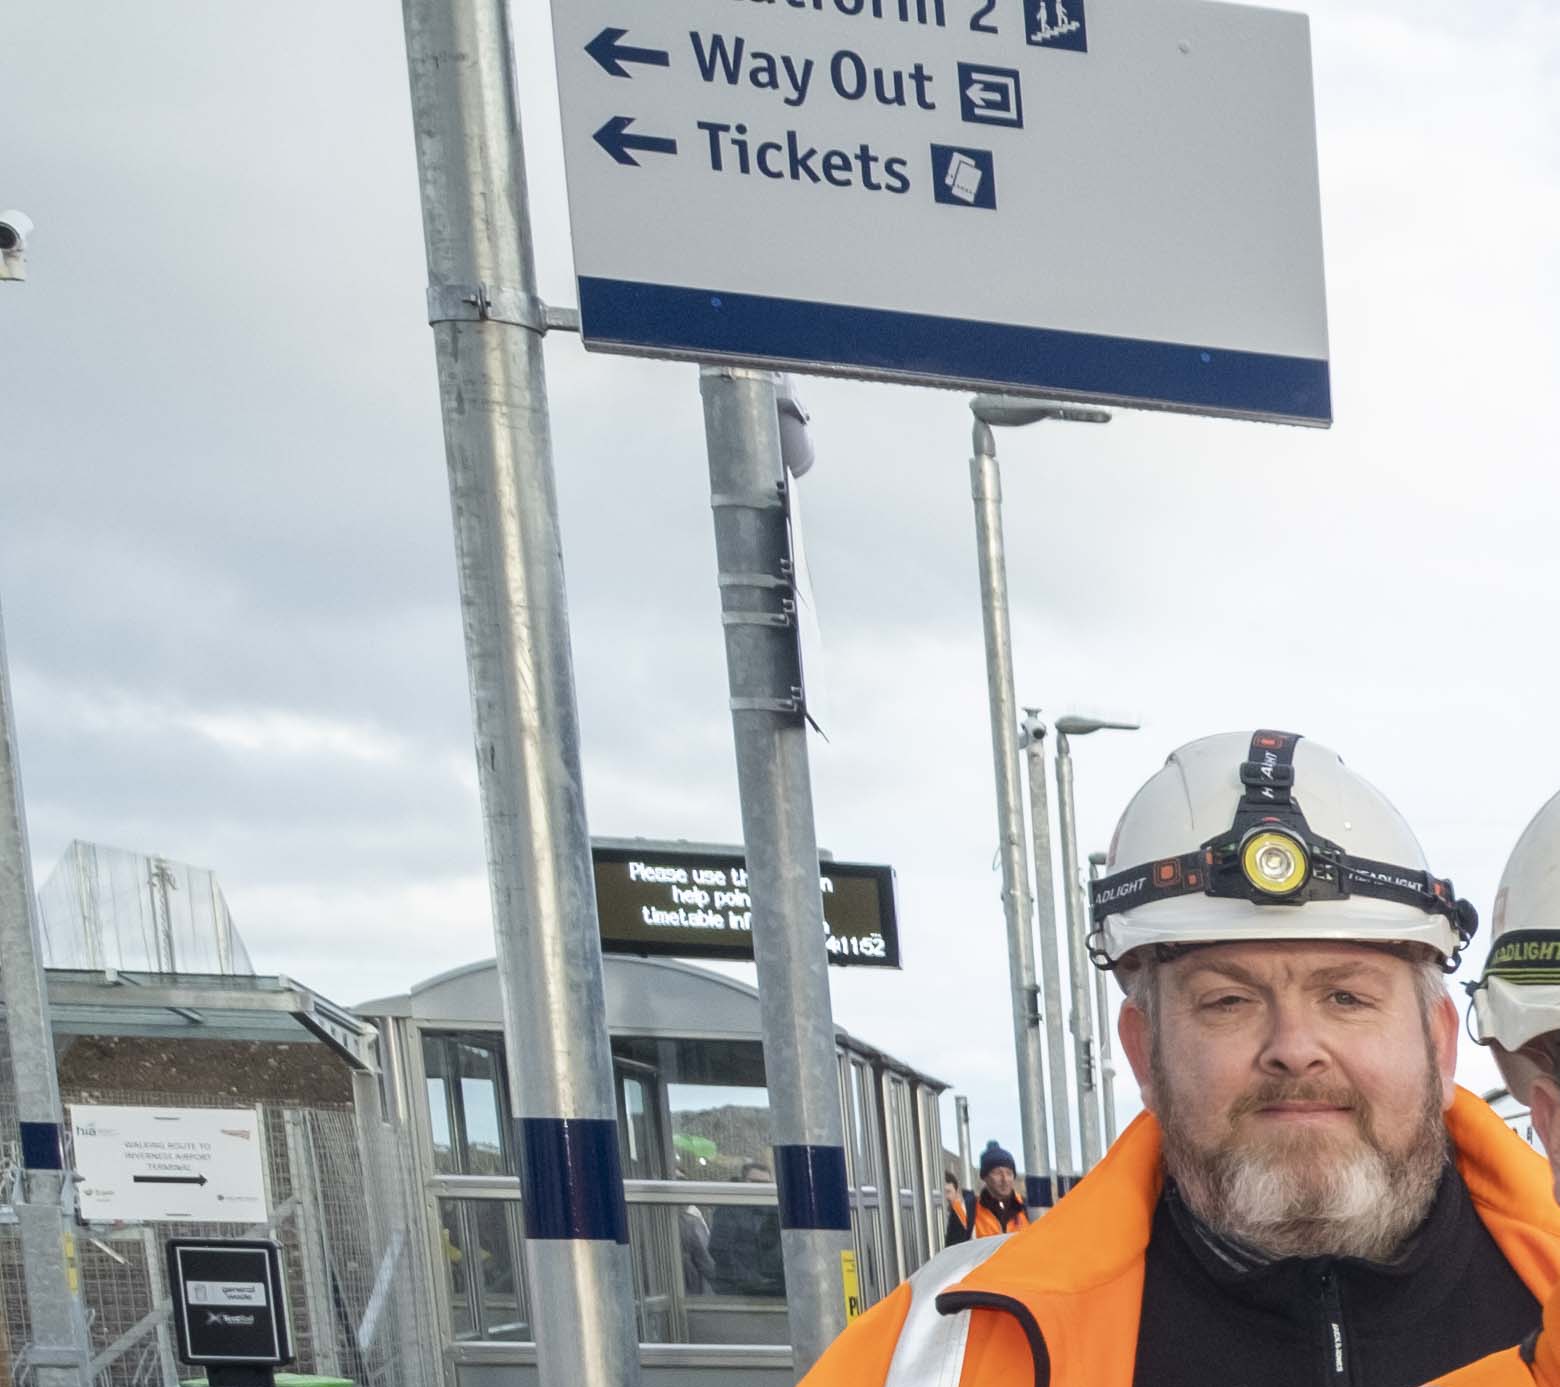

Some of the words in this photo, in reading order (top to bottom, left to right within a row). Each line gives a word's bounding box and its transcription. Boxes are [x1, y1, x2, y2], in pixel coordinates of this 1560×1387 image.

[689, 31, 814, 107] Way
[830, 49, 936, 110] Out
[696, 120, 911, 194] Tickets
[628, 862, 688, 884] Please
[692, 868, 727, 886] use
[672, 885, 710, 907] help
[1096, 877, 1147, 904] ADLIGHT
[641, 906, 725, 930] timetable
